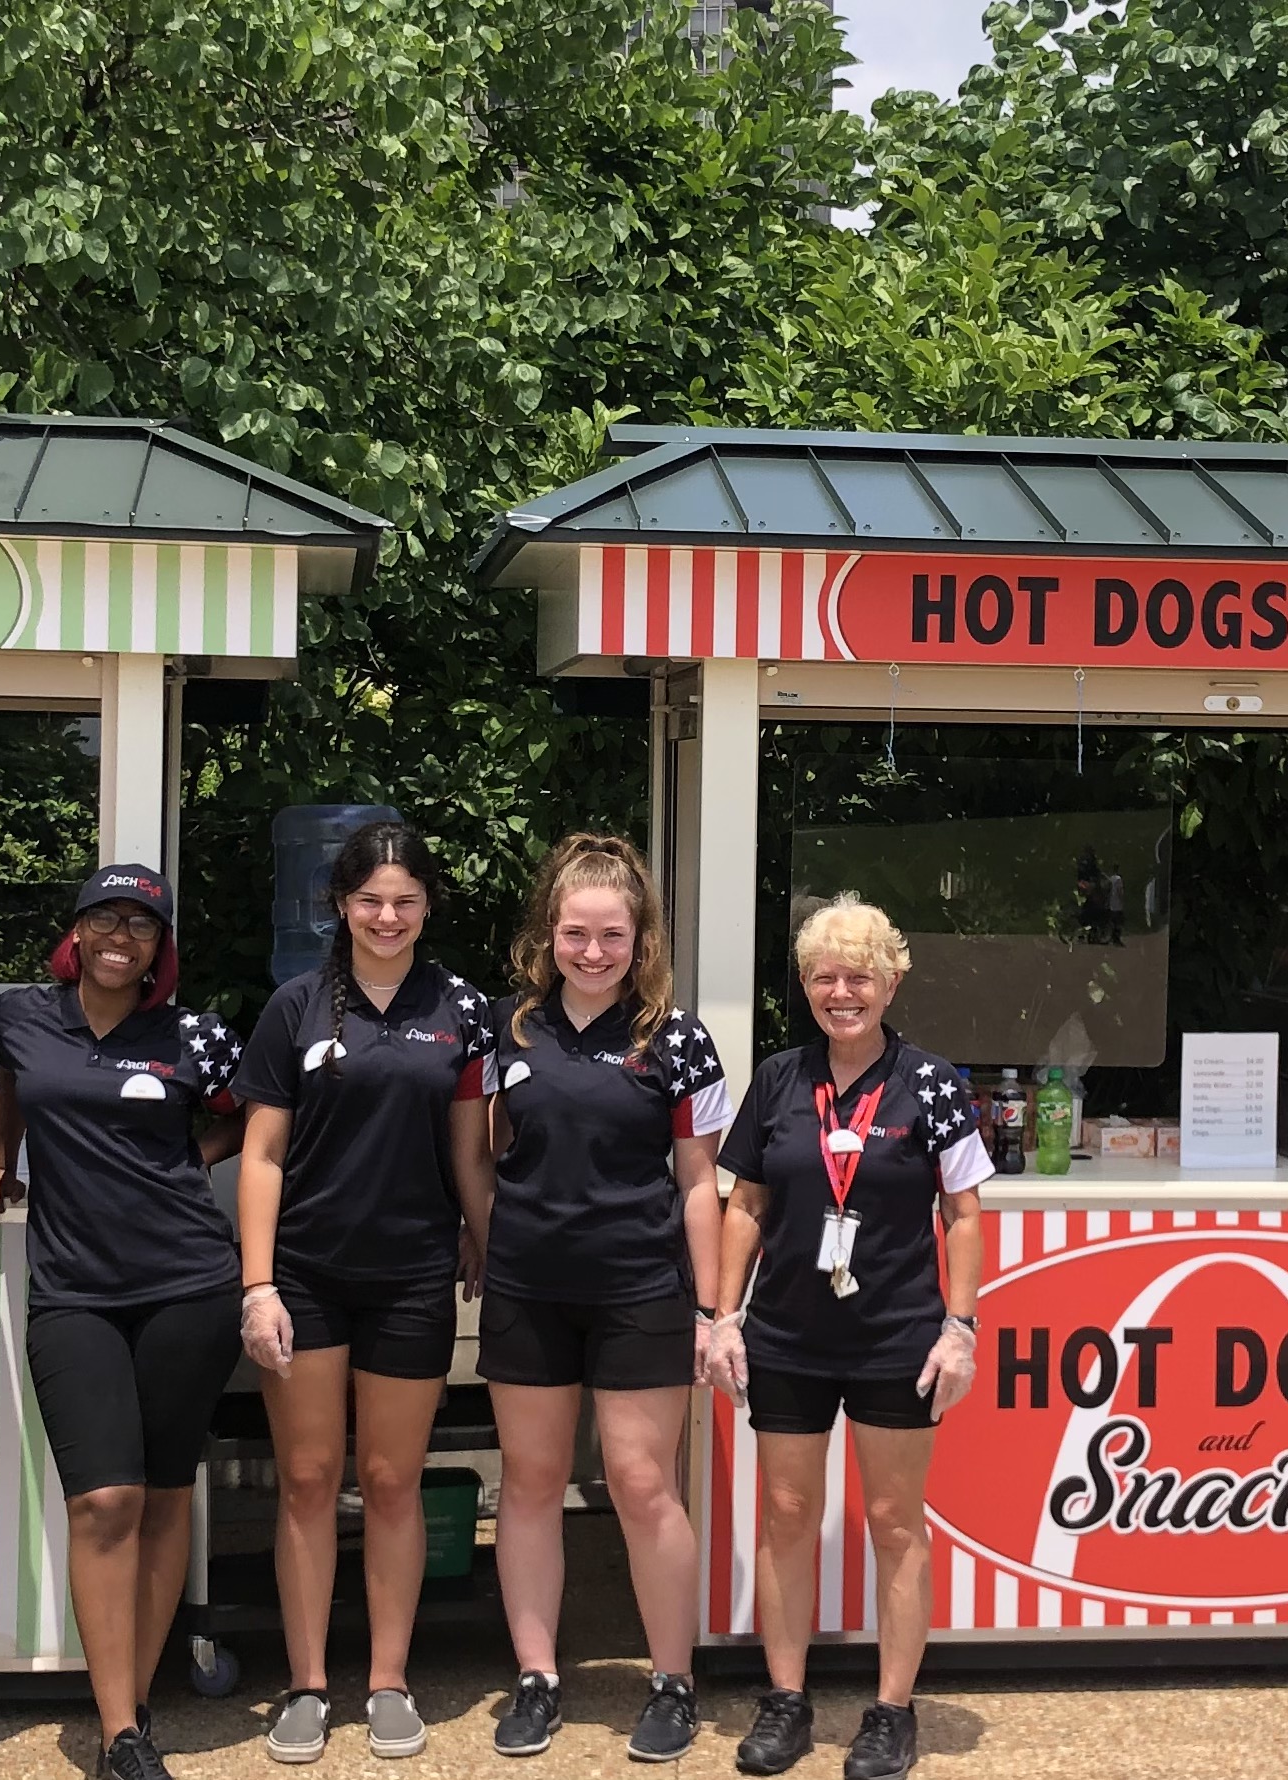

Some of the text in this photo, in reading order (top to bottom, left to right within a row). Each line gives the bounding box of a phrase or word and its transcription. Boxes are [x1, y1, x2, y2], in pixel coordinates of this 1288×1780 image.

[912, 574, 1059, 645] HOT
[1094, 578, 1288, 651] DOGS
[996, 1325, 1173, 1410] HOT
[1197, 1420, 1266, 1453] and
